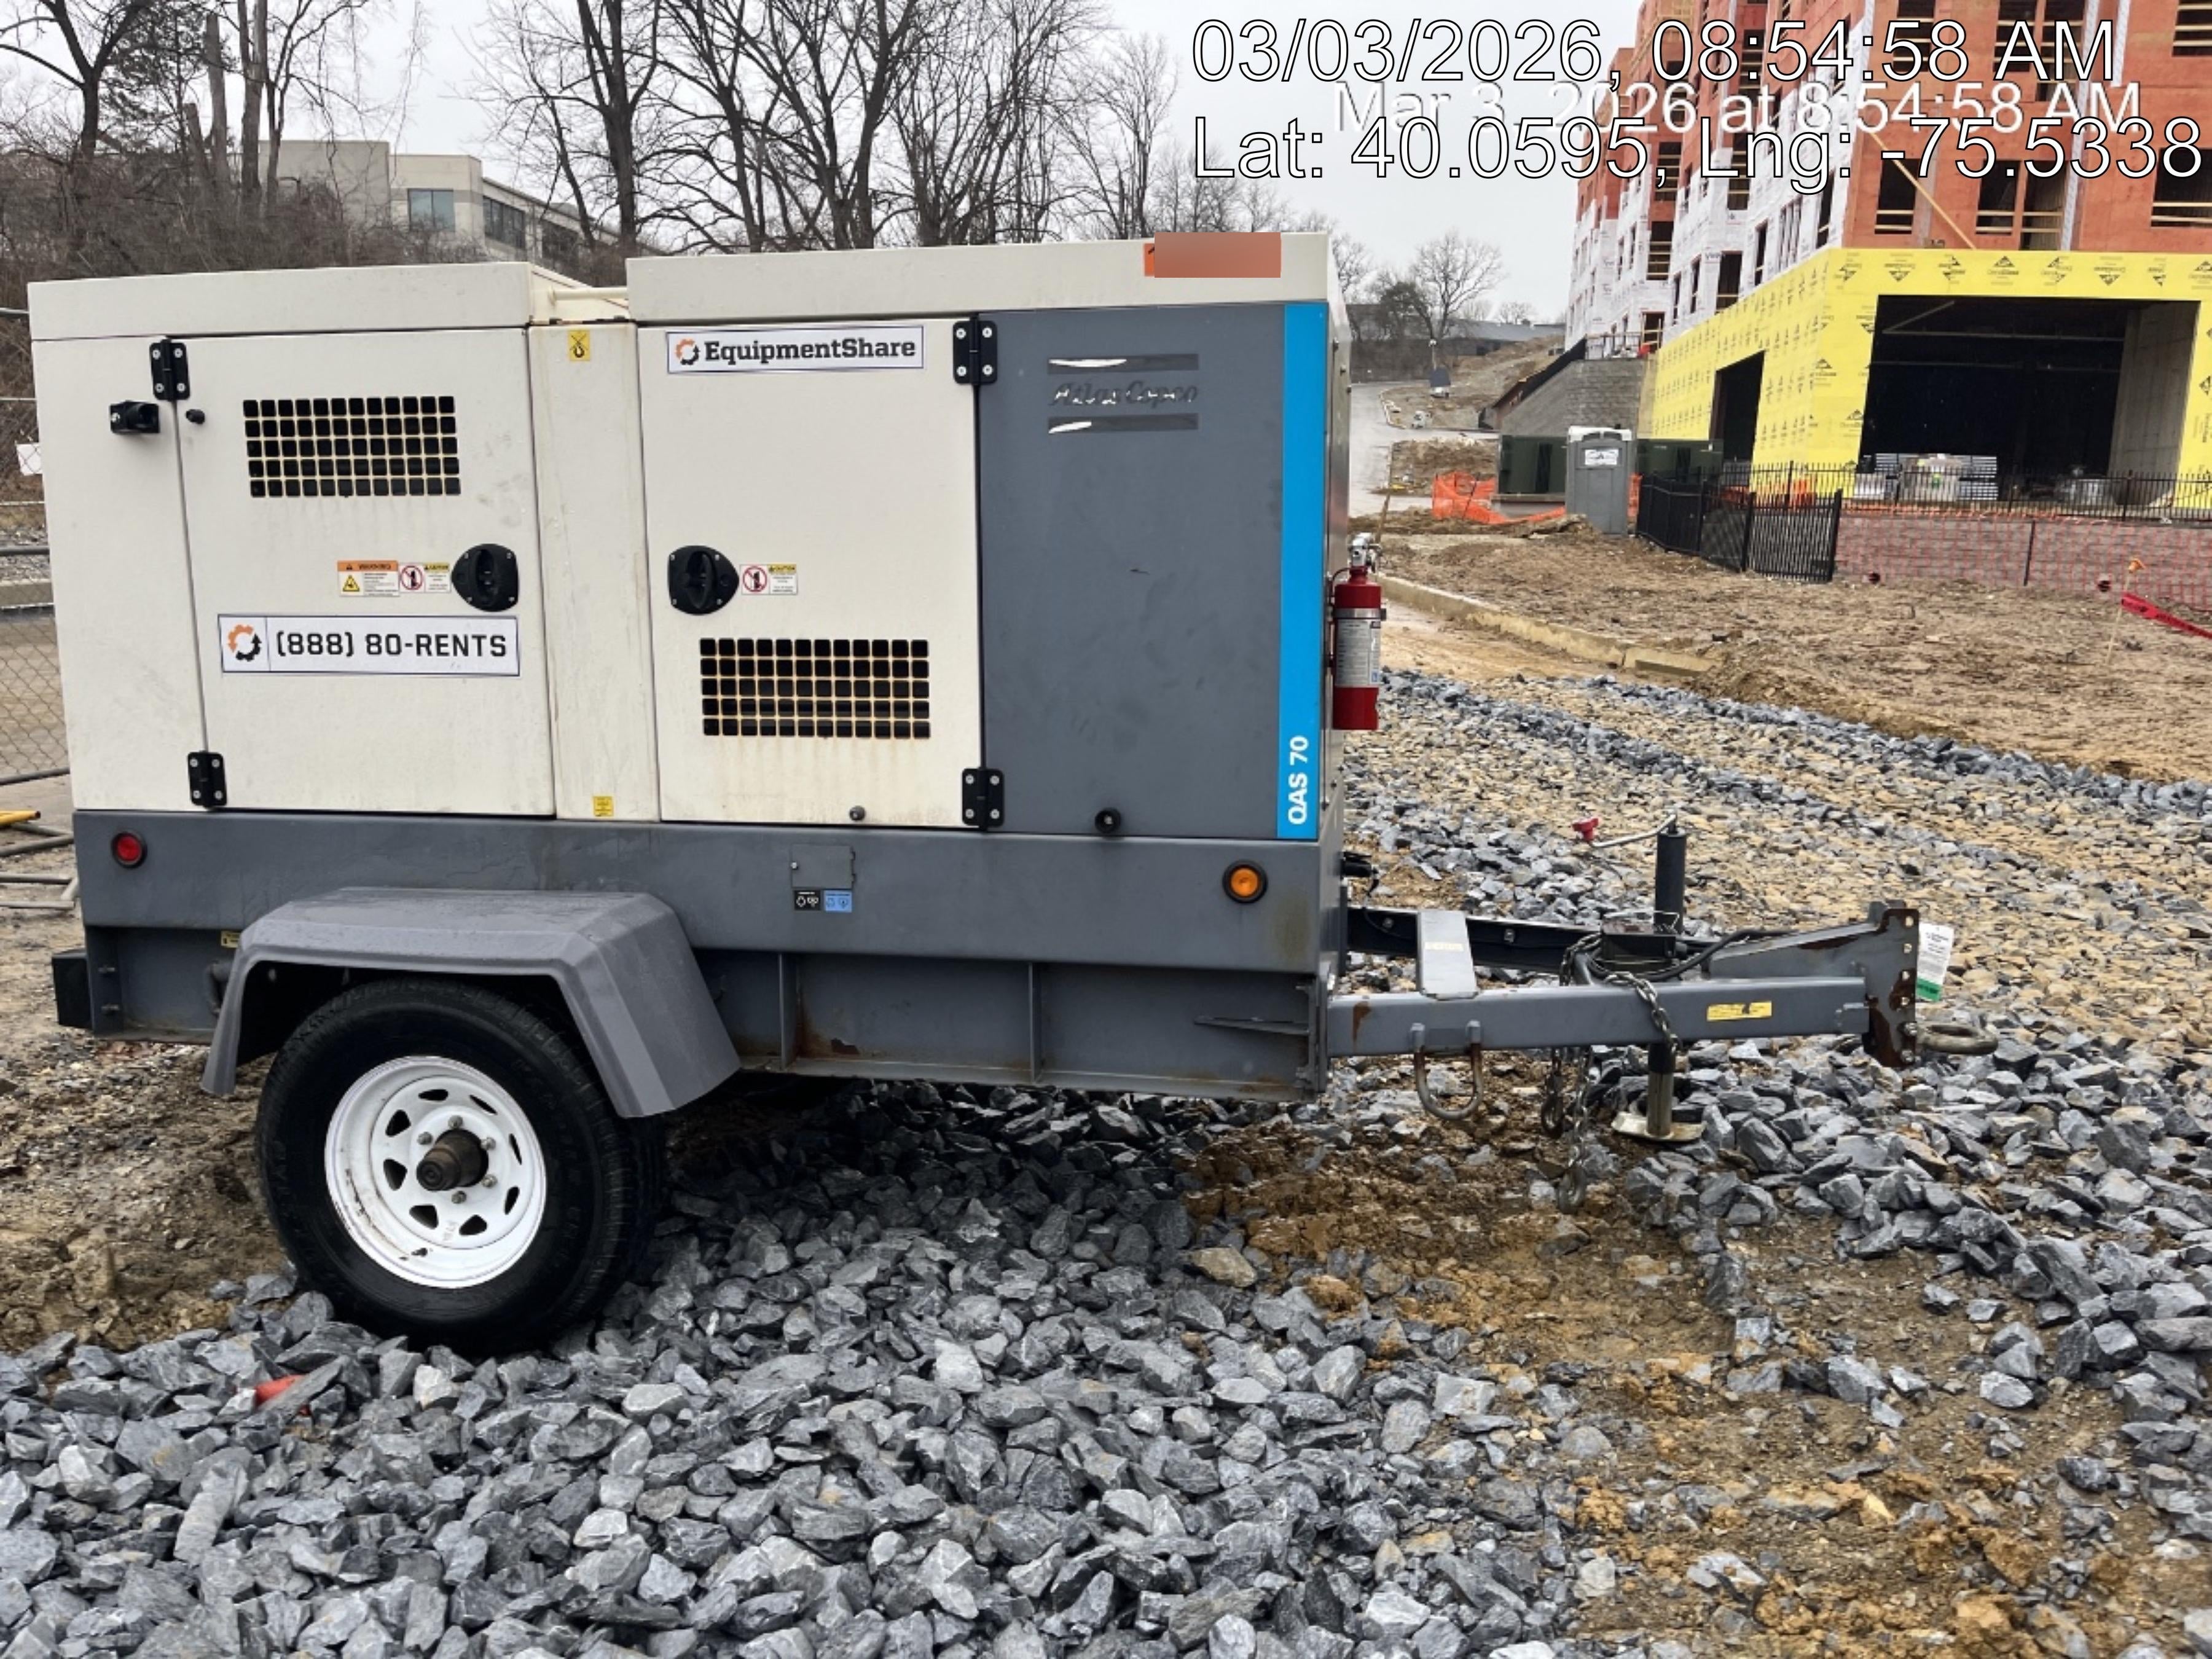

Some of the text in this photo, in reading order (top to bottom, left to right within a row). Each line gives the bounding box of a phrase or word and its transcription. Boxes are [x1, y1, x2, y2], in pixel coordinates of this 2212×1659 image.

[704, 337, 916, 366] EquipmentShare
[276, 630, 508, 657] (888) 80-RENTS
[1287, 735, 1309, 825] QAS 70
